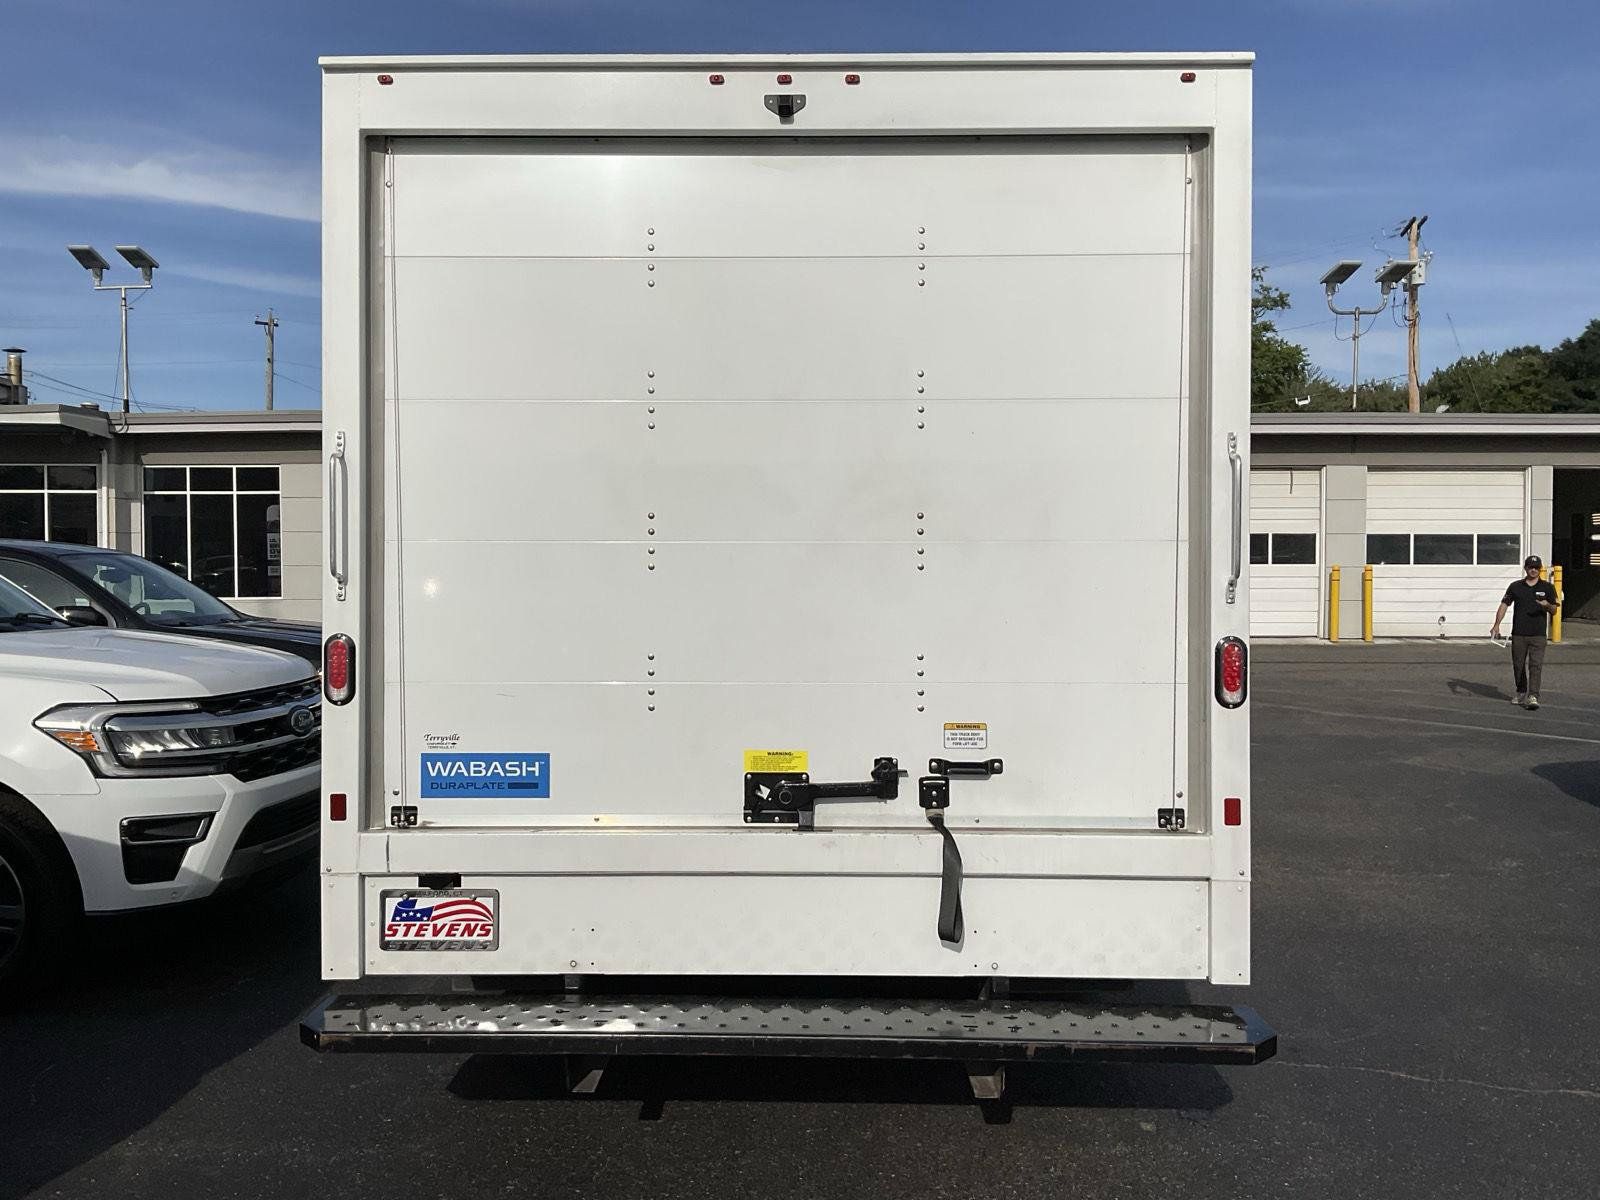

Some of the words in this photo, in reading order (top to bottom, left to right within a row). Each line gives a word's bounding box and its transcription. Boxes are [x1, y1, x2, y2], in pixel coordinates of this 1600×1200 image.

[424, 733, 460, 743] Terryville
[426, 761, 540, 777] WABASH
[430, 782, 506, 790] DURAPLATE
[384, 923, 494, 938] STEVENS
[386, 940, 493, 951] STEVENS
